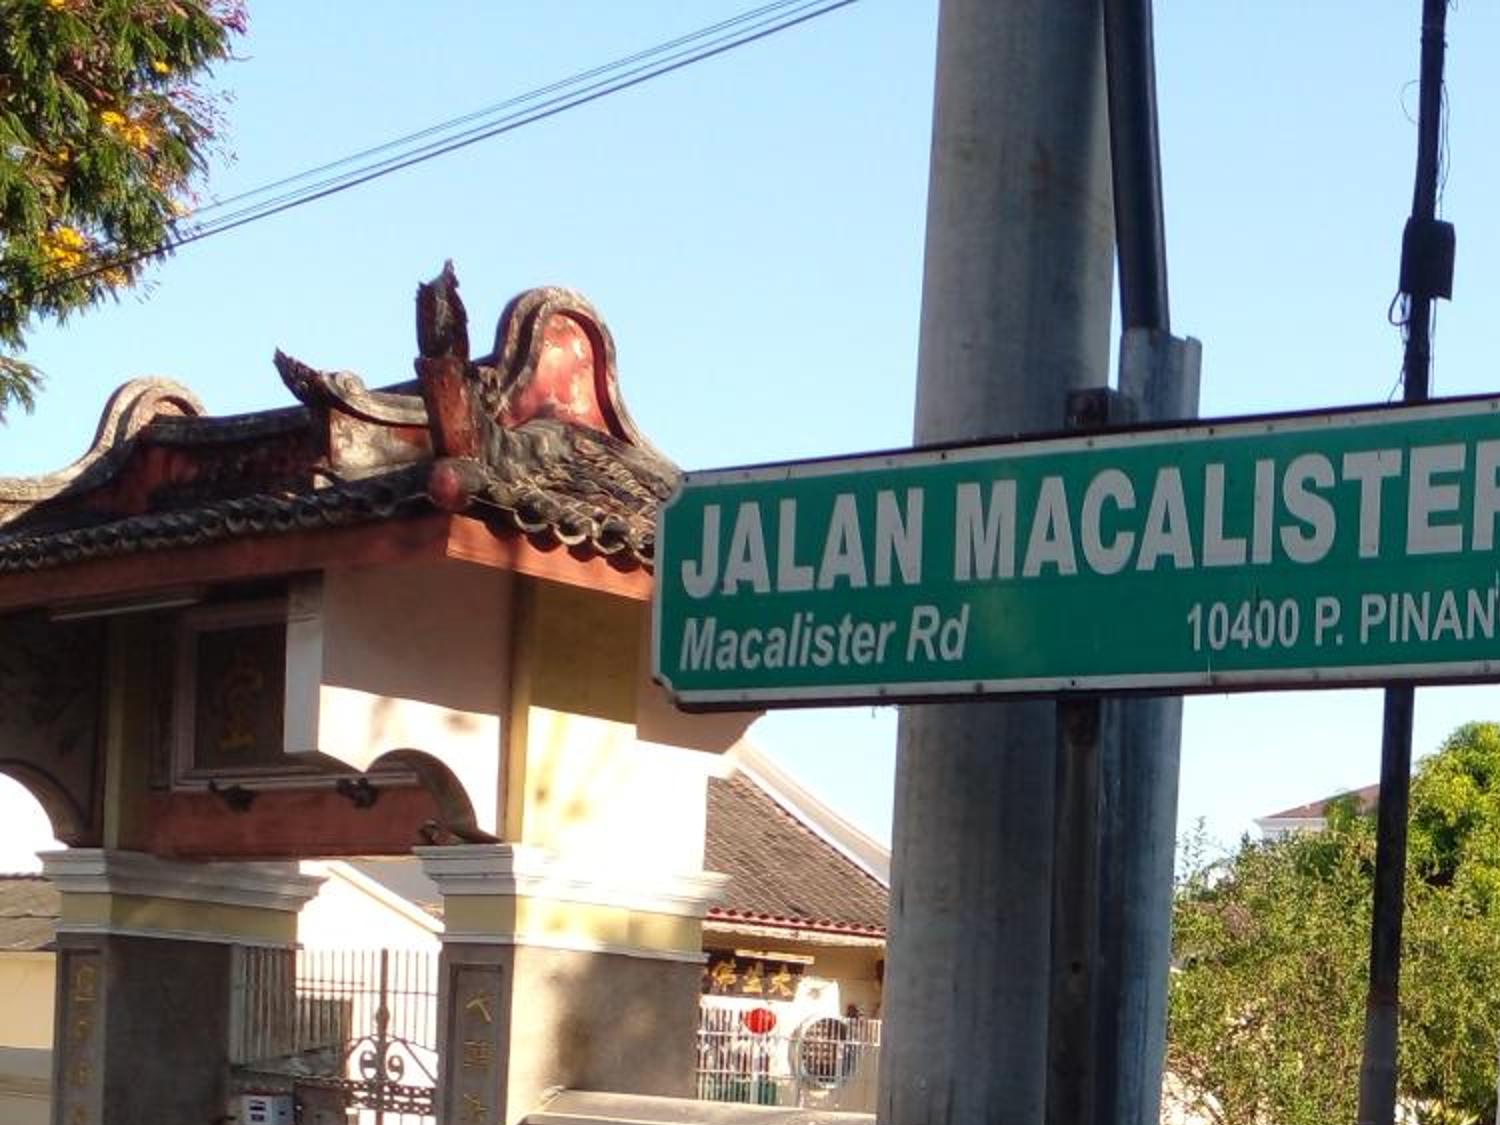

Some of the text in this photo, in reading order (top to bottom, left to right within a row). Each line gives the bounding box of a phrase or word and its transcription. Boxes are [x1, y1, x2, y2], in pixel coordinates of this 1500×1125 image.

[681, 488, 925, 599] JALAN
[679, 603, 968, 671] Macalister Rd
[1185, 598, 1300, 652] 10400
[1313, 598, 1345, 646] P.
